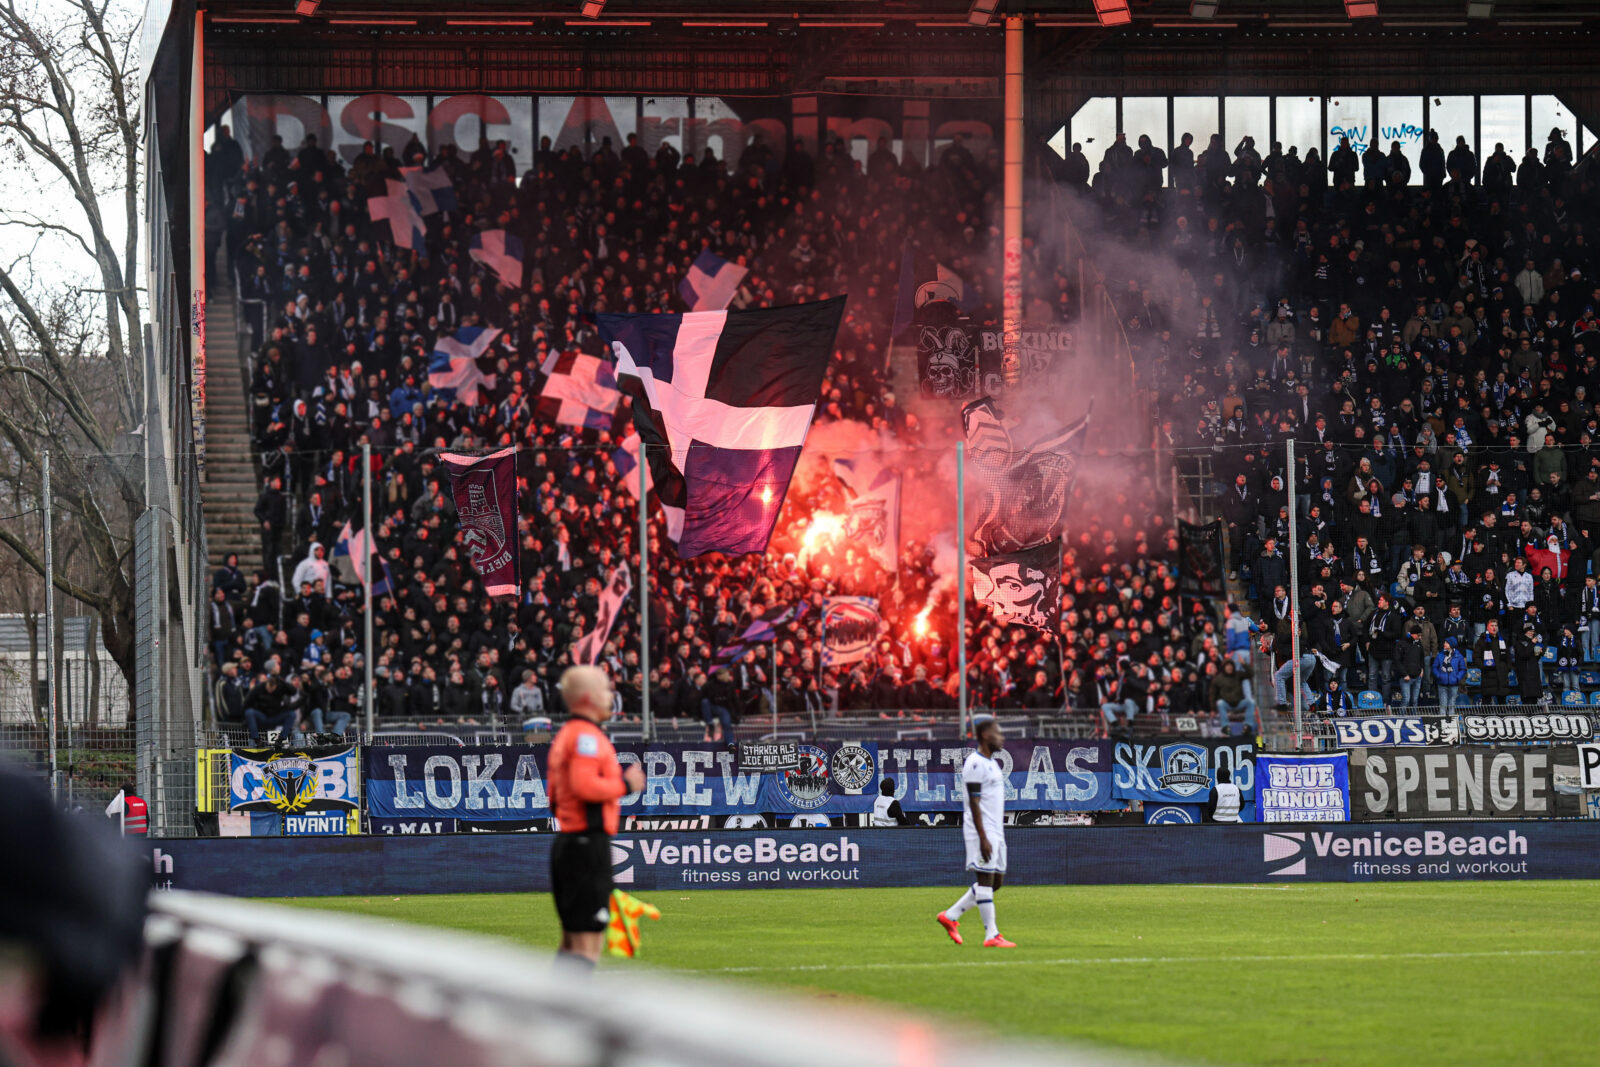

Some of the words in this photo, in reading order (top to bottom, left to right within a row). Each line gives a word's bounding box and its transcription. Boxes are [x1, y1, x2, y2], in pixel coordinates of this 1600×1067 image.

[1180, 720, 1195, 729] 26
[1335, 718, 1426, 744] BOYS
[780, 743, 795, 754] ALS
[836, 747, 869, 759] SEKTION
[742, 755, 762, 766] JEDE
[764, 753, 798, 765] AUFLAGE
[1114, 742, 1160, 792] SK
[1214, 744, 1254, 792] 05
[388, 753, 552, 810] LOKA
[833, 766, 874, 789] STADIONVERBOT
[1271, 766, 1334, 788] BLUE
[1364, 752, 1548, 813] SPENGE
[788, 794, 827, 808] BIELEFELD
[1264, 790, 1343, 809] HONOUR
[1265, 810, 1344, 822] BIELEFELD
[286, 817, 344, 833] AVANTI
[639, 836, 860, 865] VeniceBeach
[1311, 829, 1528, 857] VeniceBeach
[681, 868, 741, 883] fitness
[747, 868, 780, 882] and
[786, 867, 860, 882] workout
[1353, 861, 1411, 875] fitness
[1417, 860, 1450, 874] and
[1456, 859, 1528, 873] workout
